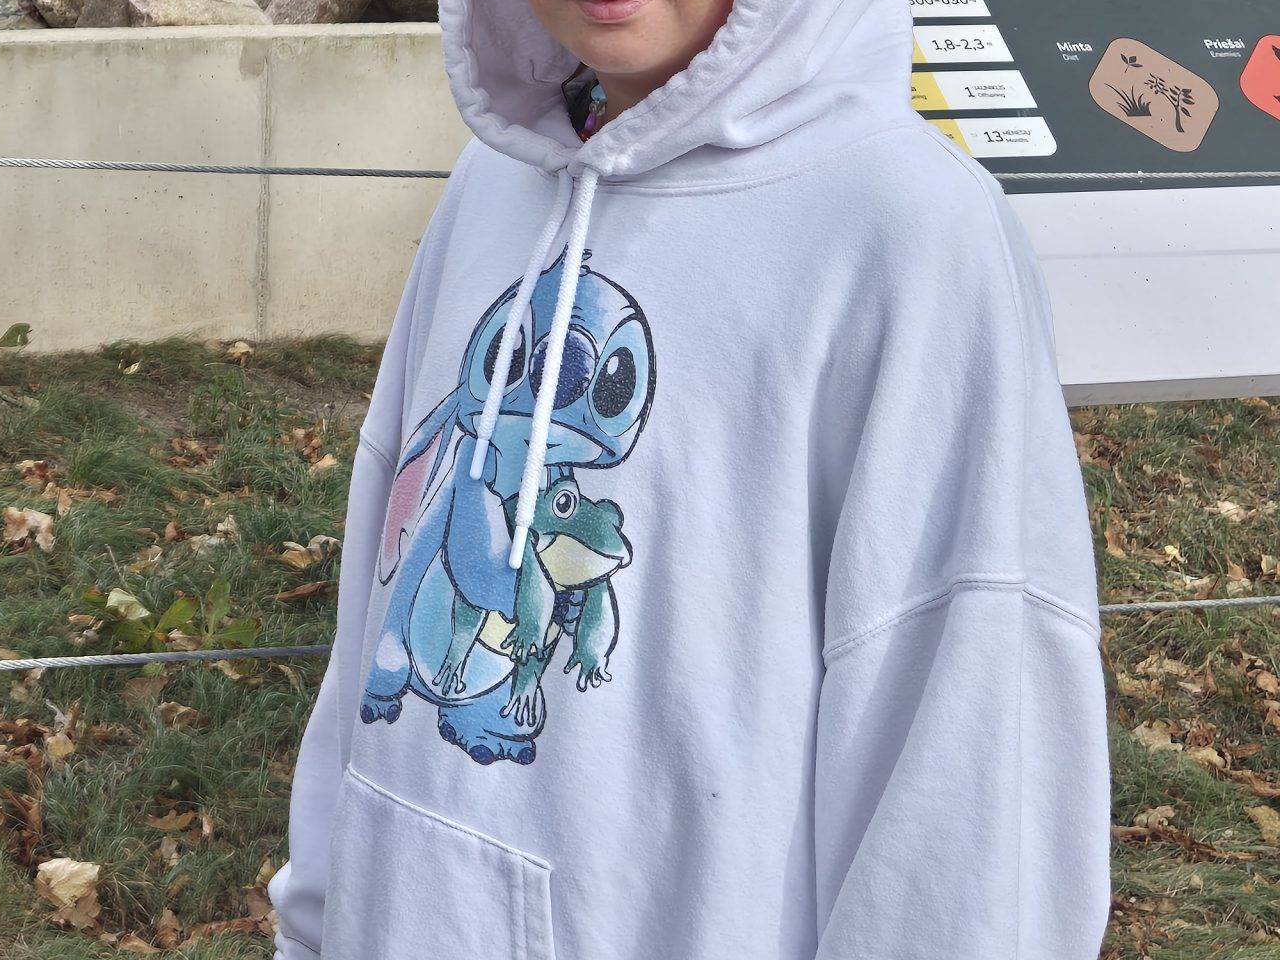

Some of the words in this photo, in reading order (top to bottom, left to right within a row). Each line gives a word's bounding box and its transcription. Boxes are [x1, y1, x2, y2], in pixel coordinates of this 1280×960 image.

[932, 39, 984, 51] 1,8-2,3
[1056, 42, 1092, 52] Minta
[1203, 39, 1245, 50] Priešai
[964, 86, 975, 98] 1
[984, 130, 1003, 143] 13
